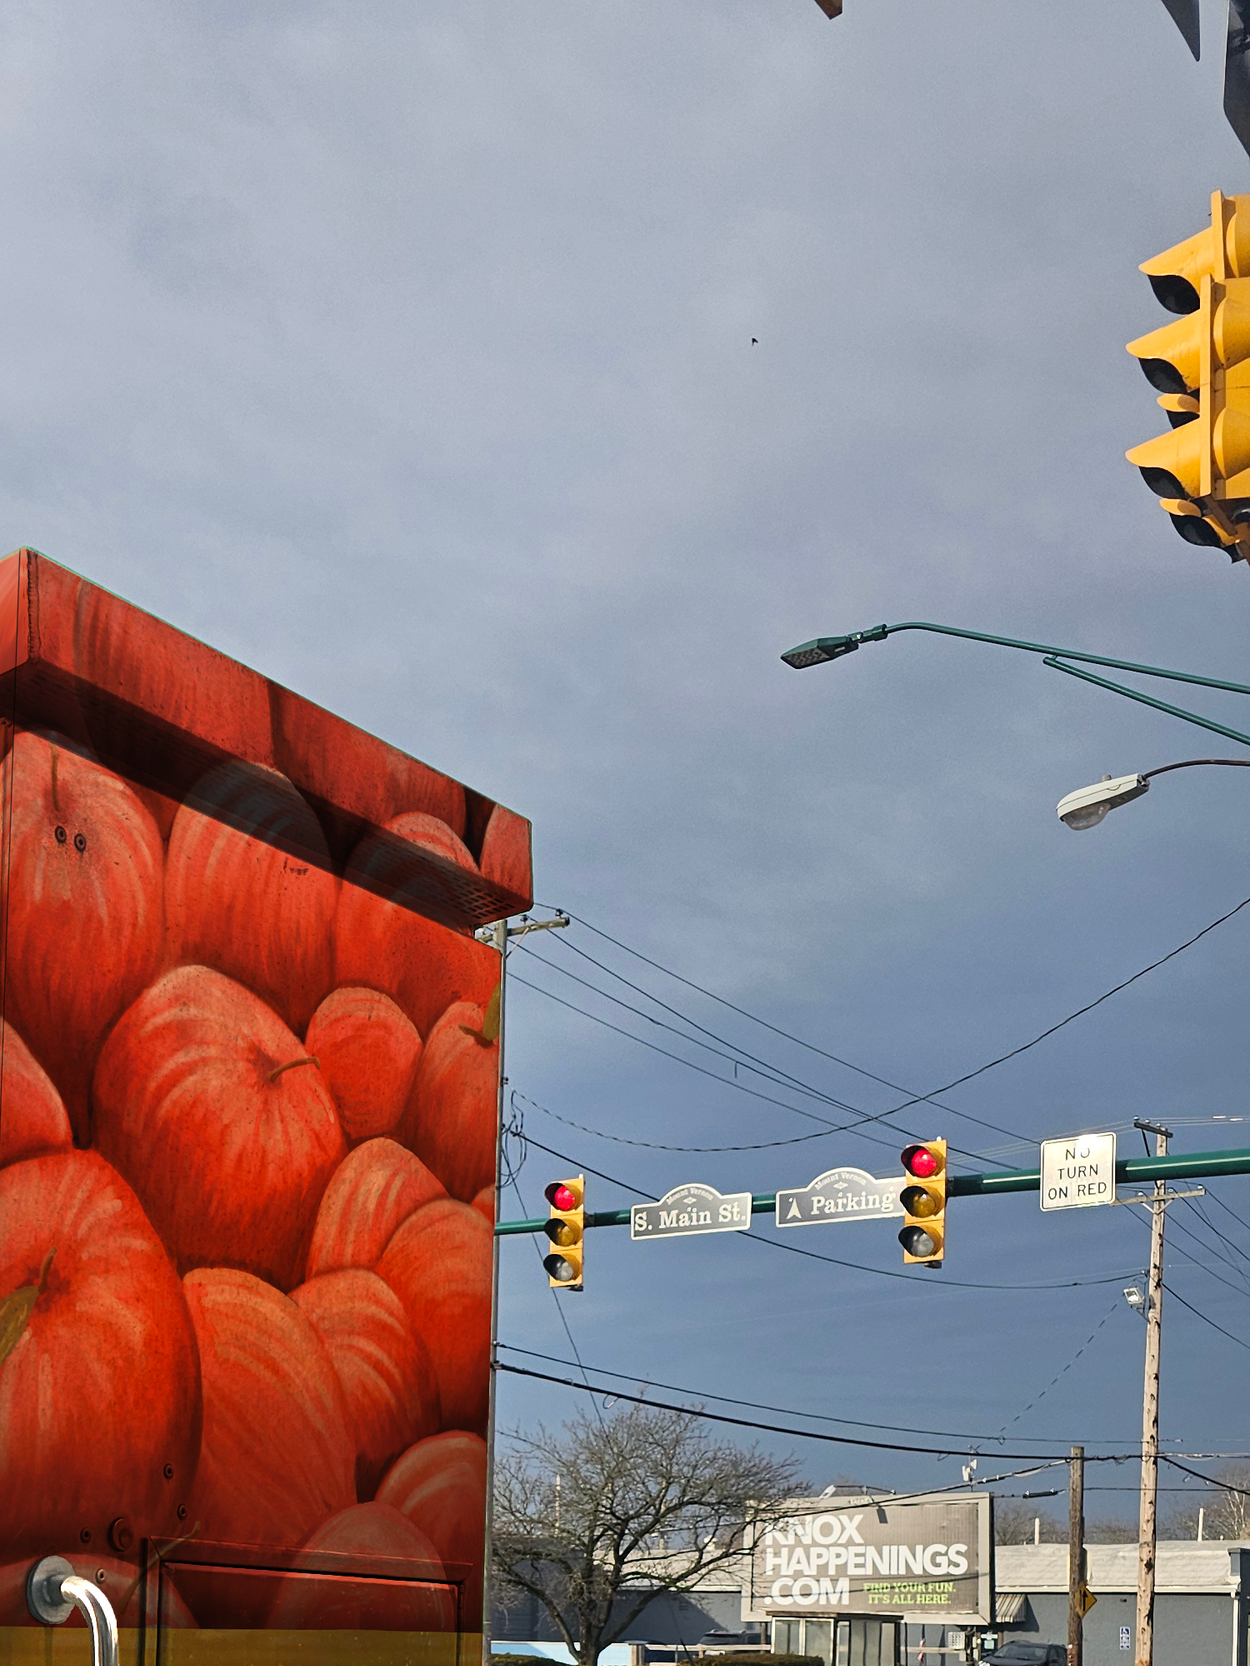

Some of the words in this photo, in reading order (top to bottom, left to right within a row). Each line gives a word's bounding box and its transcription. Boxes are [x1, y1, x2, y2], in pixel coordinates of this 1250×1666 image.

[1066, 1147, 1090, 1160] NO
[1057, 1163, 1098, 1180] TURN
[815, 1173, 839, 1190] Mount
[841, 1172, 867, 1186] Vernon
[666, 1188, 689, 1205] Mount
[690, 1187, 714, 1201] Vernon
[1048, 1186, 1068, 1200] ON
[1077, 1182, 1107, 1197] RED
[811, 1190, 896, 1215] Parking
[635, 1211, 653, 1231] S.
[659, 1207, 712, 1228] Main
[718, 1201, 746, 1222] St.
[765, 1514, 865, 1545] KNOX
[765, 1543, 969, 1576] HAPPENINGS
[764, 1577, 850, 1605] .COM
[863, 1582, 891, 1593] FIND
[893, 1582, 926, 1593] YOUR
[928, 1582, 957, 1593] FUN.
[868, 1593, 890, 1604] IT'S
[892, 1593, 915, 1604] ALL
[916, 1593, 952, 1604] HERE.
